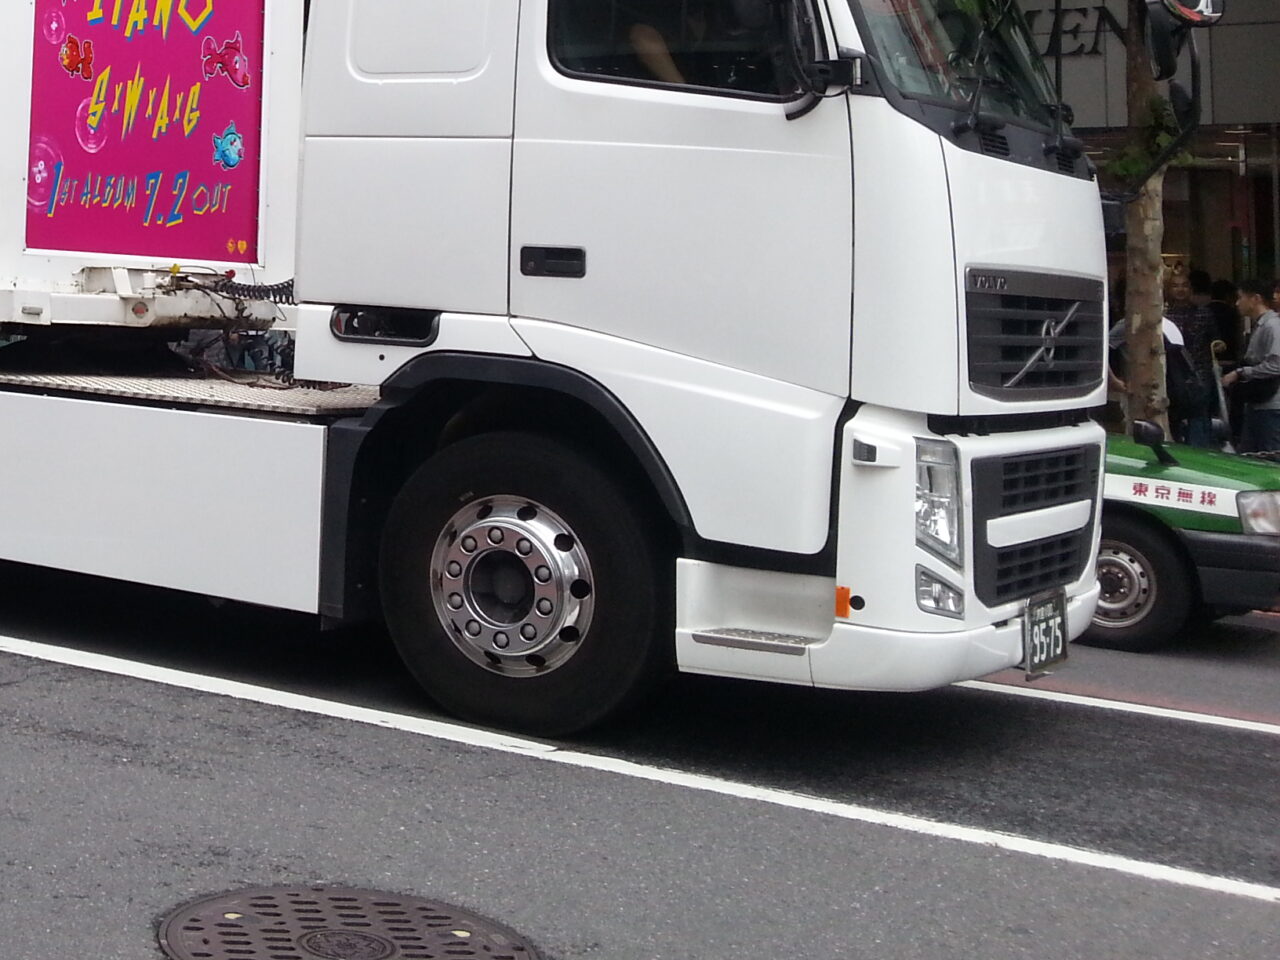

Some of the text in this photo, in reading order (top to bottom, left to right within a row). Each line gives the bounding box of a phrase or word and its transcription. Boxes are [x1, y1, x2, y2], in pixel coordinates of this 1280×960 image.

[80, 169, 138, 212] ALBUM
[142, 170, 191, 228] 7.2
[192, 183, 232, 216] OUT
[973, 274, 1008, 290] VOLVO
[1132, 482, 1217, 506] 東京無線
[1033, 616, 1063, 664] 95-75
